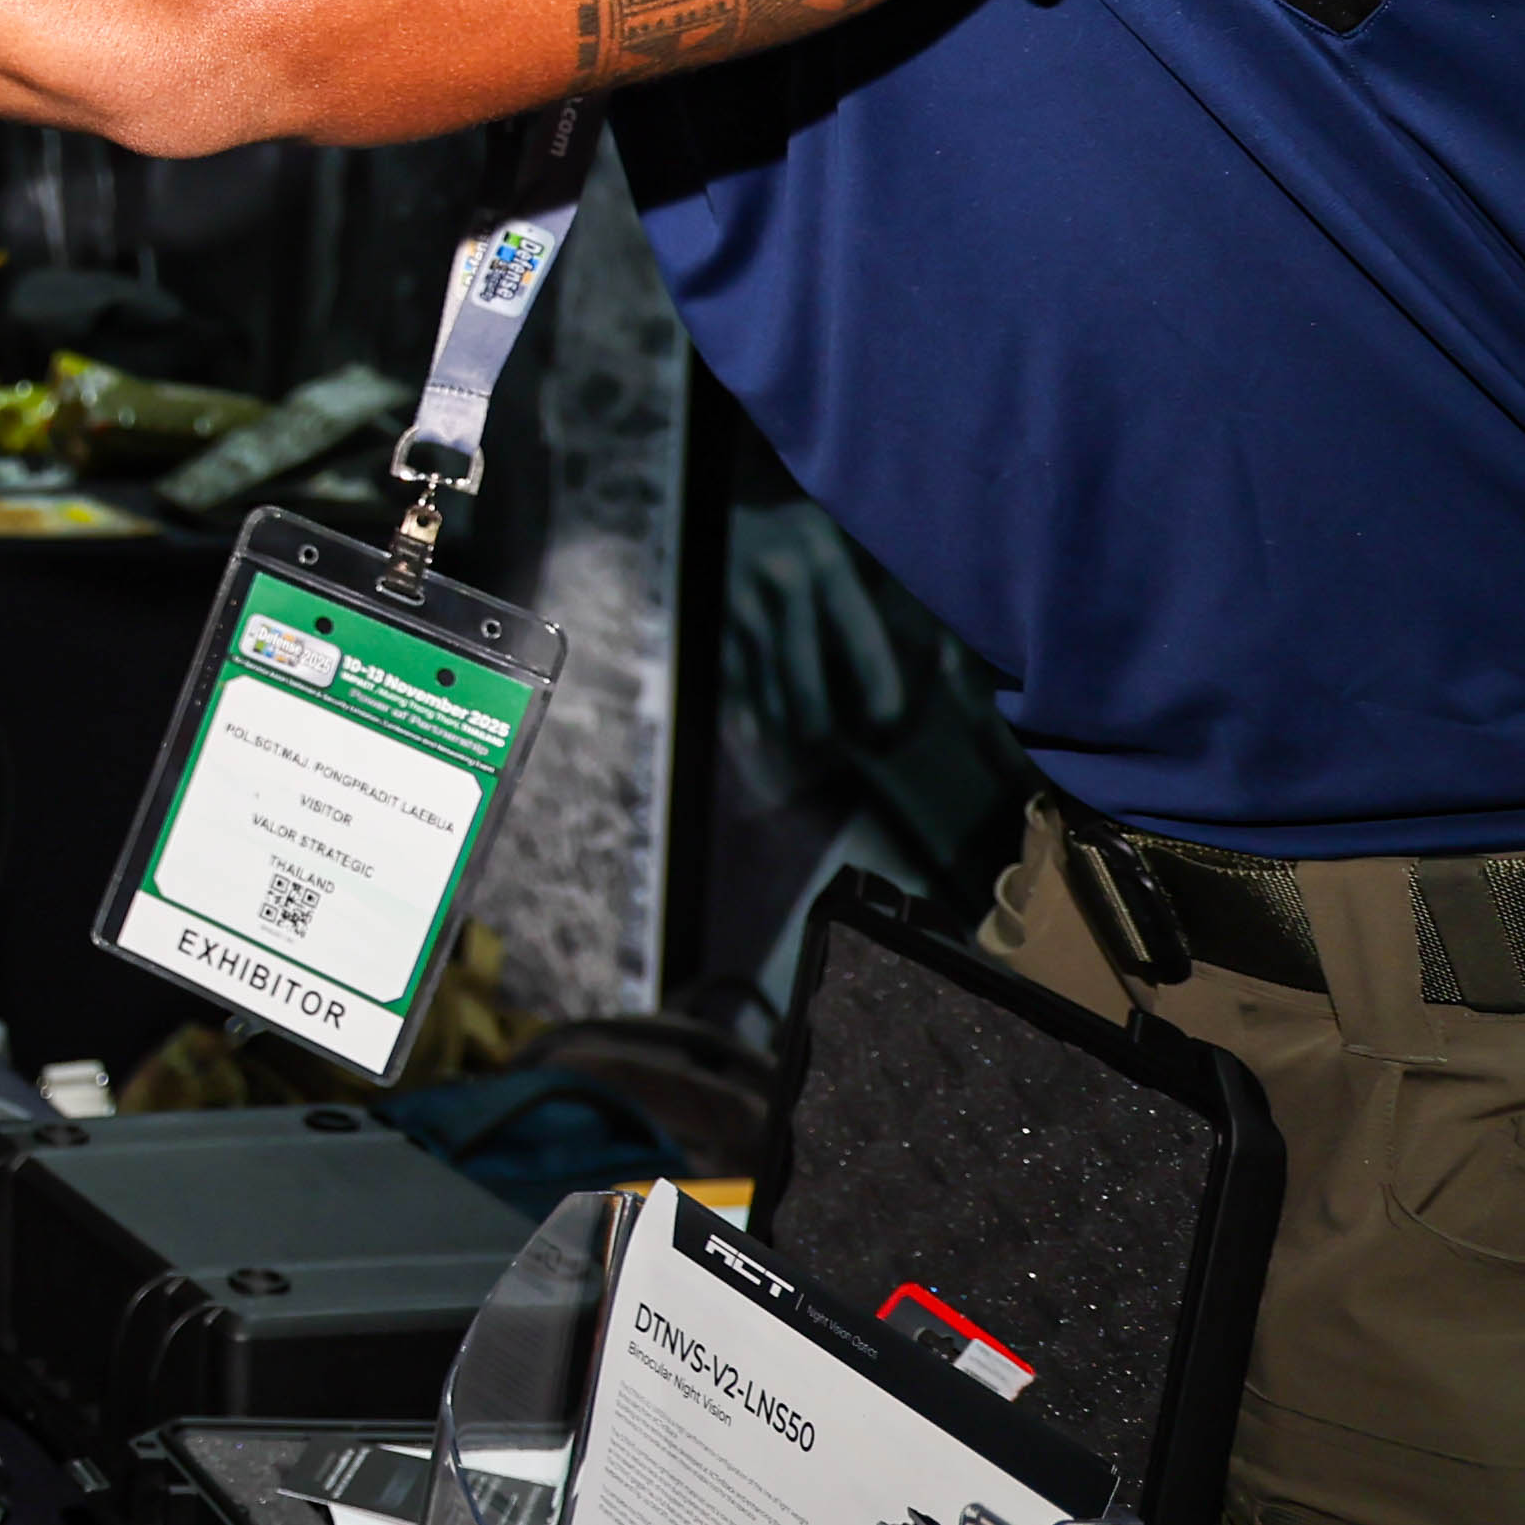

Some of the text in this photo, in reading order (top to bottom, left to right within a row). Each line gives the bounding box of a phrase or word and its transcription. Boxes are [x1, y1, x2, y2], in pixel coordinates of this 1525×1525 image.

[494, 237, 544, 301] Defense
[300, 648, 332, 674] 2025
[382, 672, 469, 719] November
[467, 710, 510, 737] 2025
[298, 793, 353, 826] VISITOR
[252, 813, 376, 879] VALOR STRATEGIC
[268, 854, 336, 894] THAILAND
[177, 928, 347, 1029] EXHIBITOR
[627, 1341, 732, 1427] Binocular Night Vision
[634, 1302, 815, 1452] DTNVS-V2-LNS50
